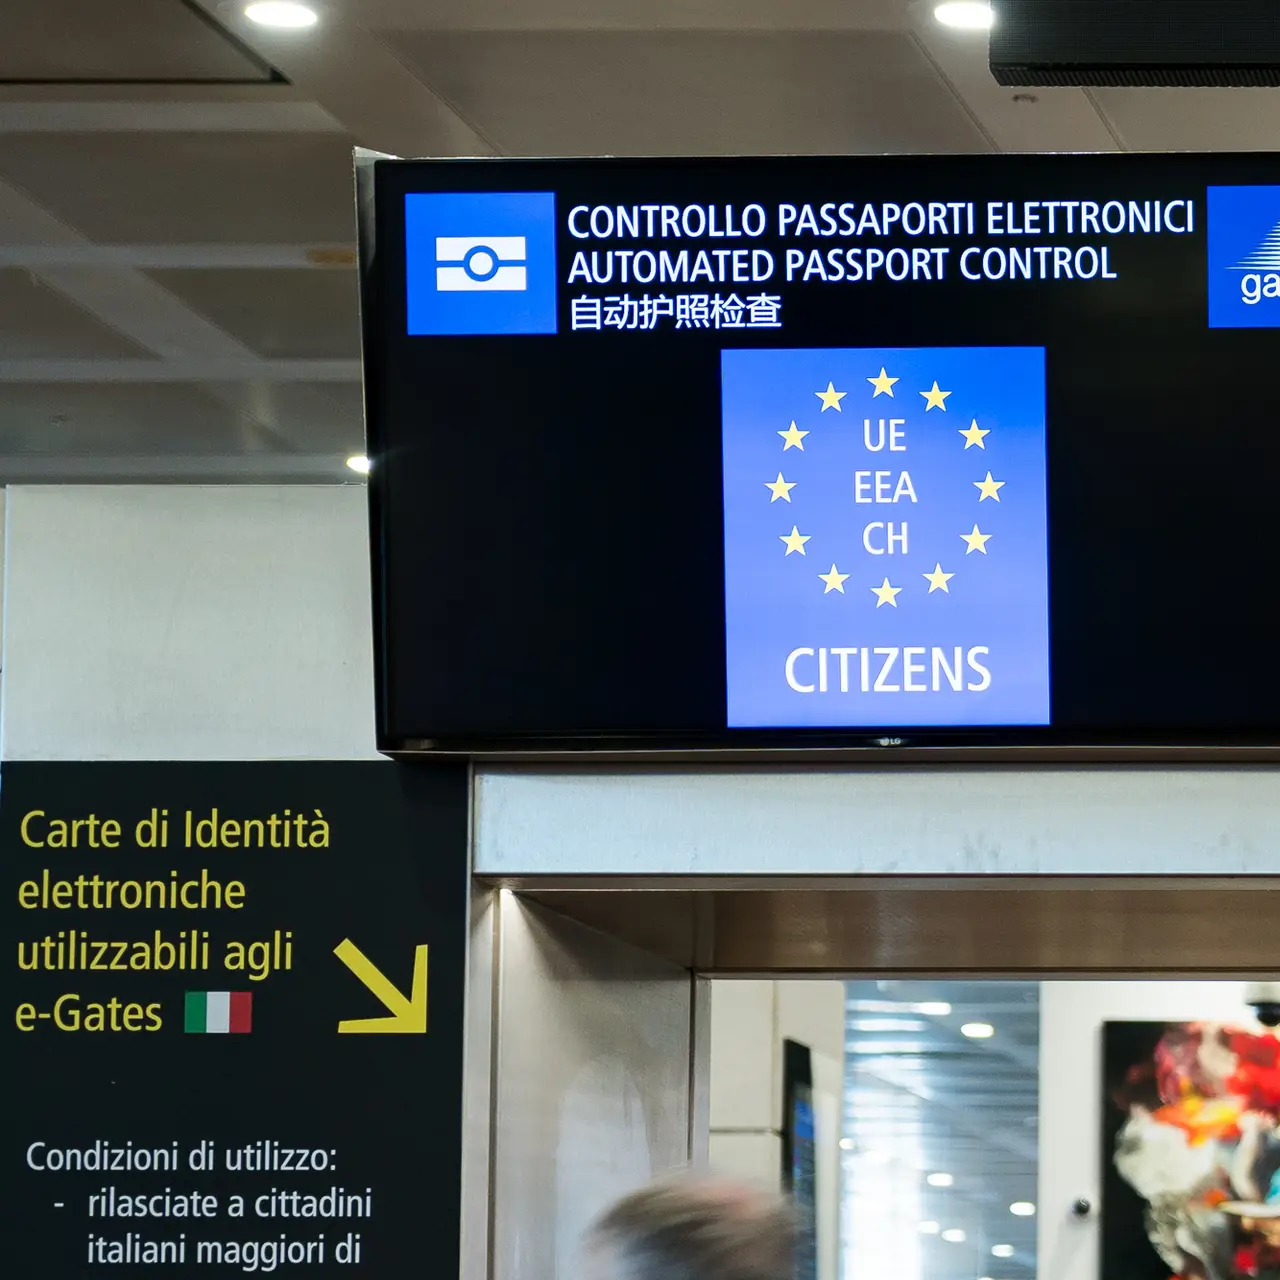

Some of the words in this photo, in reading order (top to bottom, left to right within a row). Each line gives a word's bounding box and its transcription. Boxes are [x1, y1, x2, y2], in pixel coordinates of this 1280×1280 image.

[567, 203, 766, 239] CONTROLLO
[778, 202, 974, 236] PASSAPORTI
[987, 199, 1193, 234] ELETTRONICI
[567, 249, 774, 284] AUTOMATED
[786, 247, 950, 282] PASSPORT
[959, 246, 1117, 280] CONTROL
[571, 292, 782, 331] 自动护照检查
[863, 418, 907, 452] UE
[854, 470, 918, 504] EEA
[862, 521, 908, 555] CH
[785, 645, 992, 693] CITIZENS
[20, 810, 122, 848] Carte
[135, 807, 168, 848] di
[185, 807, 330, 848] Identità
[18, 868, 246, 909] elettroniche
[18, 929, 209, 970] utilizzabili
[223, 929, 293, 981] agli
[15, 993, 163, 1032] e-Gates
[26, 1139, 178, 1171] Condizioni
[188, 1139, 214, 1171] di
[225, 1139, 337, 1171] utilizzo:
[88, 1186, 218, 1218] rilasciate
[227, 1195, 244, 1217] a
[254, 1186, 372, 1218] cittadini
[88, 1232, 186, 1264] italiani
[197, 1233, 325, 1272] maggiori
[335, 1232, 361, 1264] di
